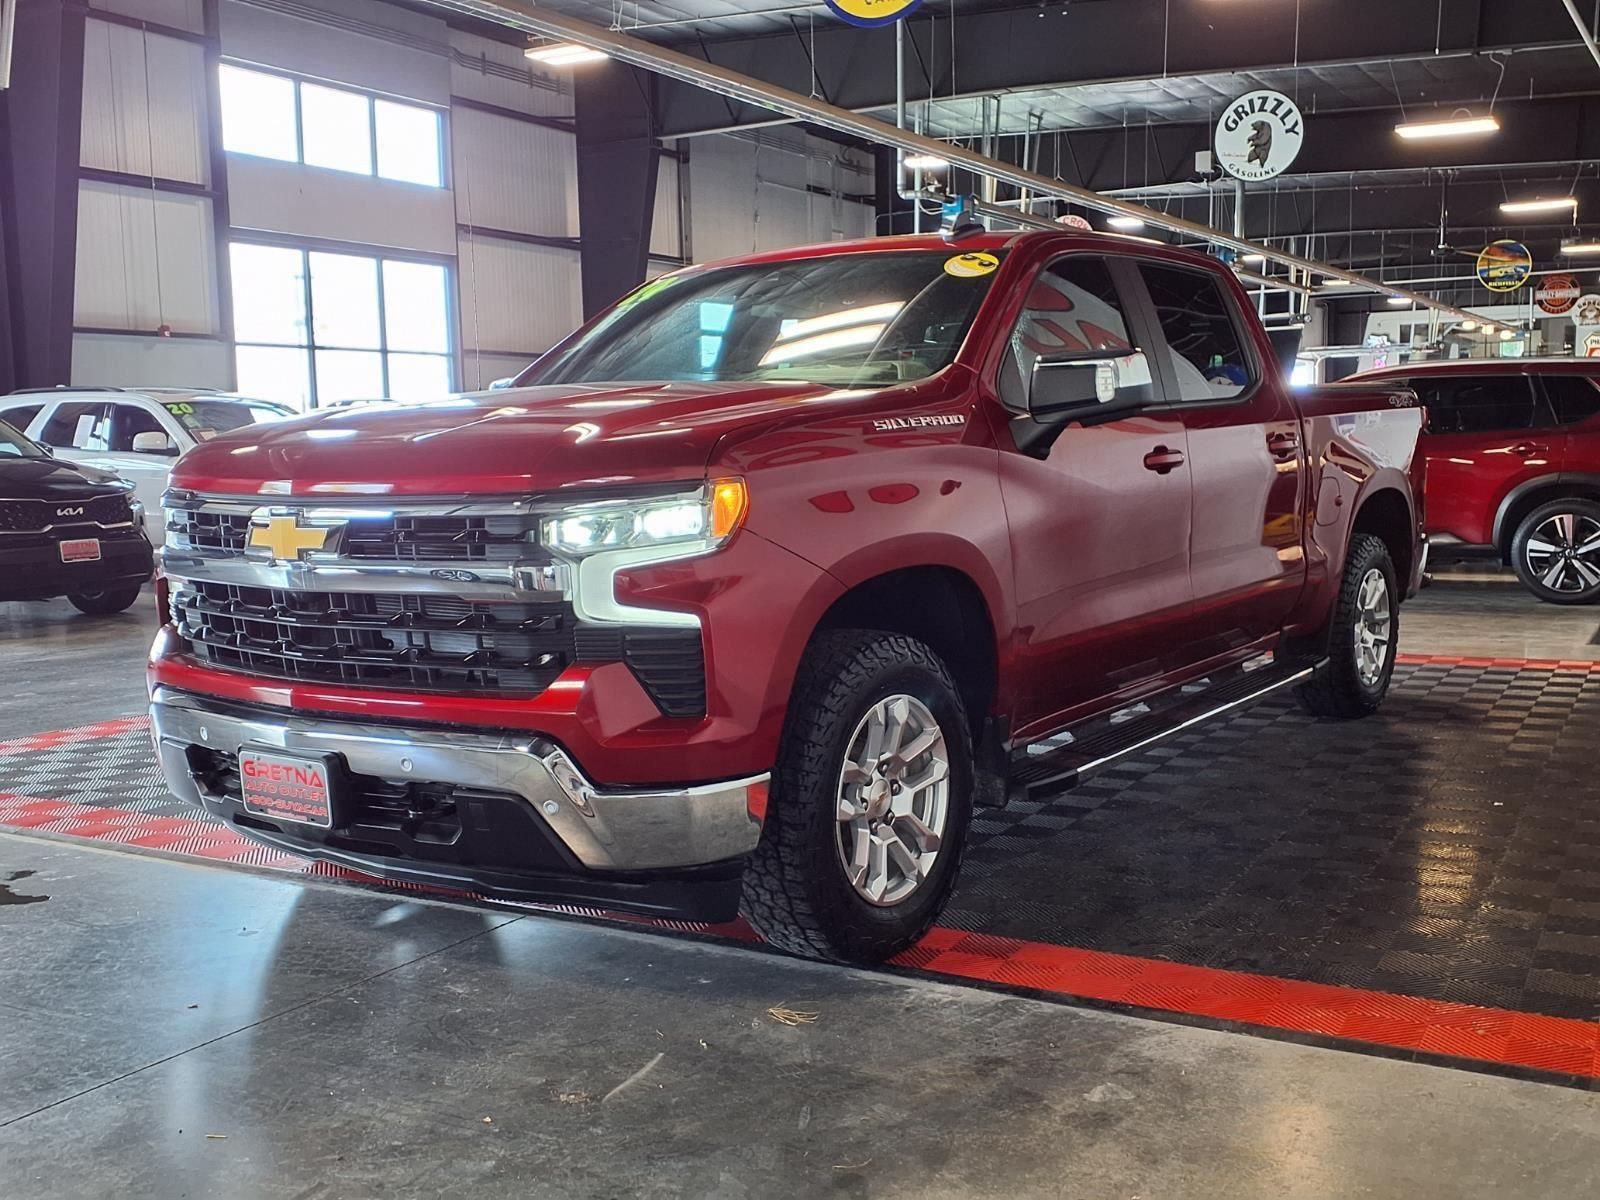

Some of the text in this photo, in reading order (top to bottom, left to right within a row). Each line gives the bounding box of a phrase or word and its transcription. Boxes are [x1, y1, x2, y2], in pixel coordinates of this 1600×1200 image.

[1224, 96, 1299, 136] GRIZZLY
[1228, 163, 1277, 178] GASOLINE
[166, 403, 194, 415] 20
[873, 415, 965, 431] SILVERADO
[243, 760, 324, 788] GRETNA
[245, 780, 326, 802] AUTO OUTLET
